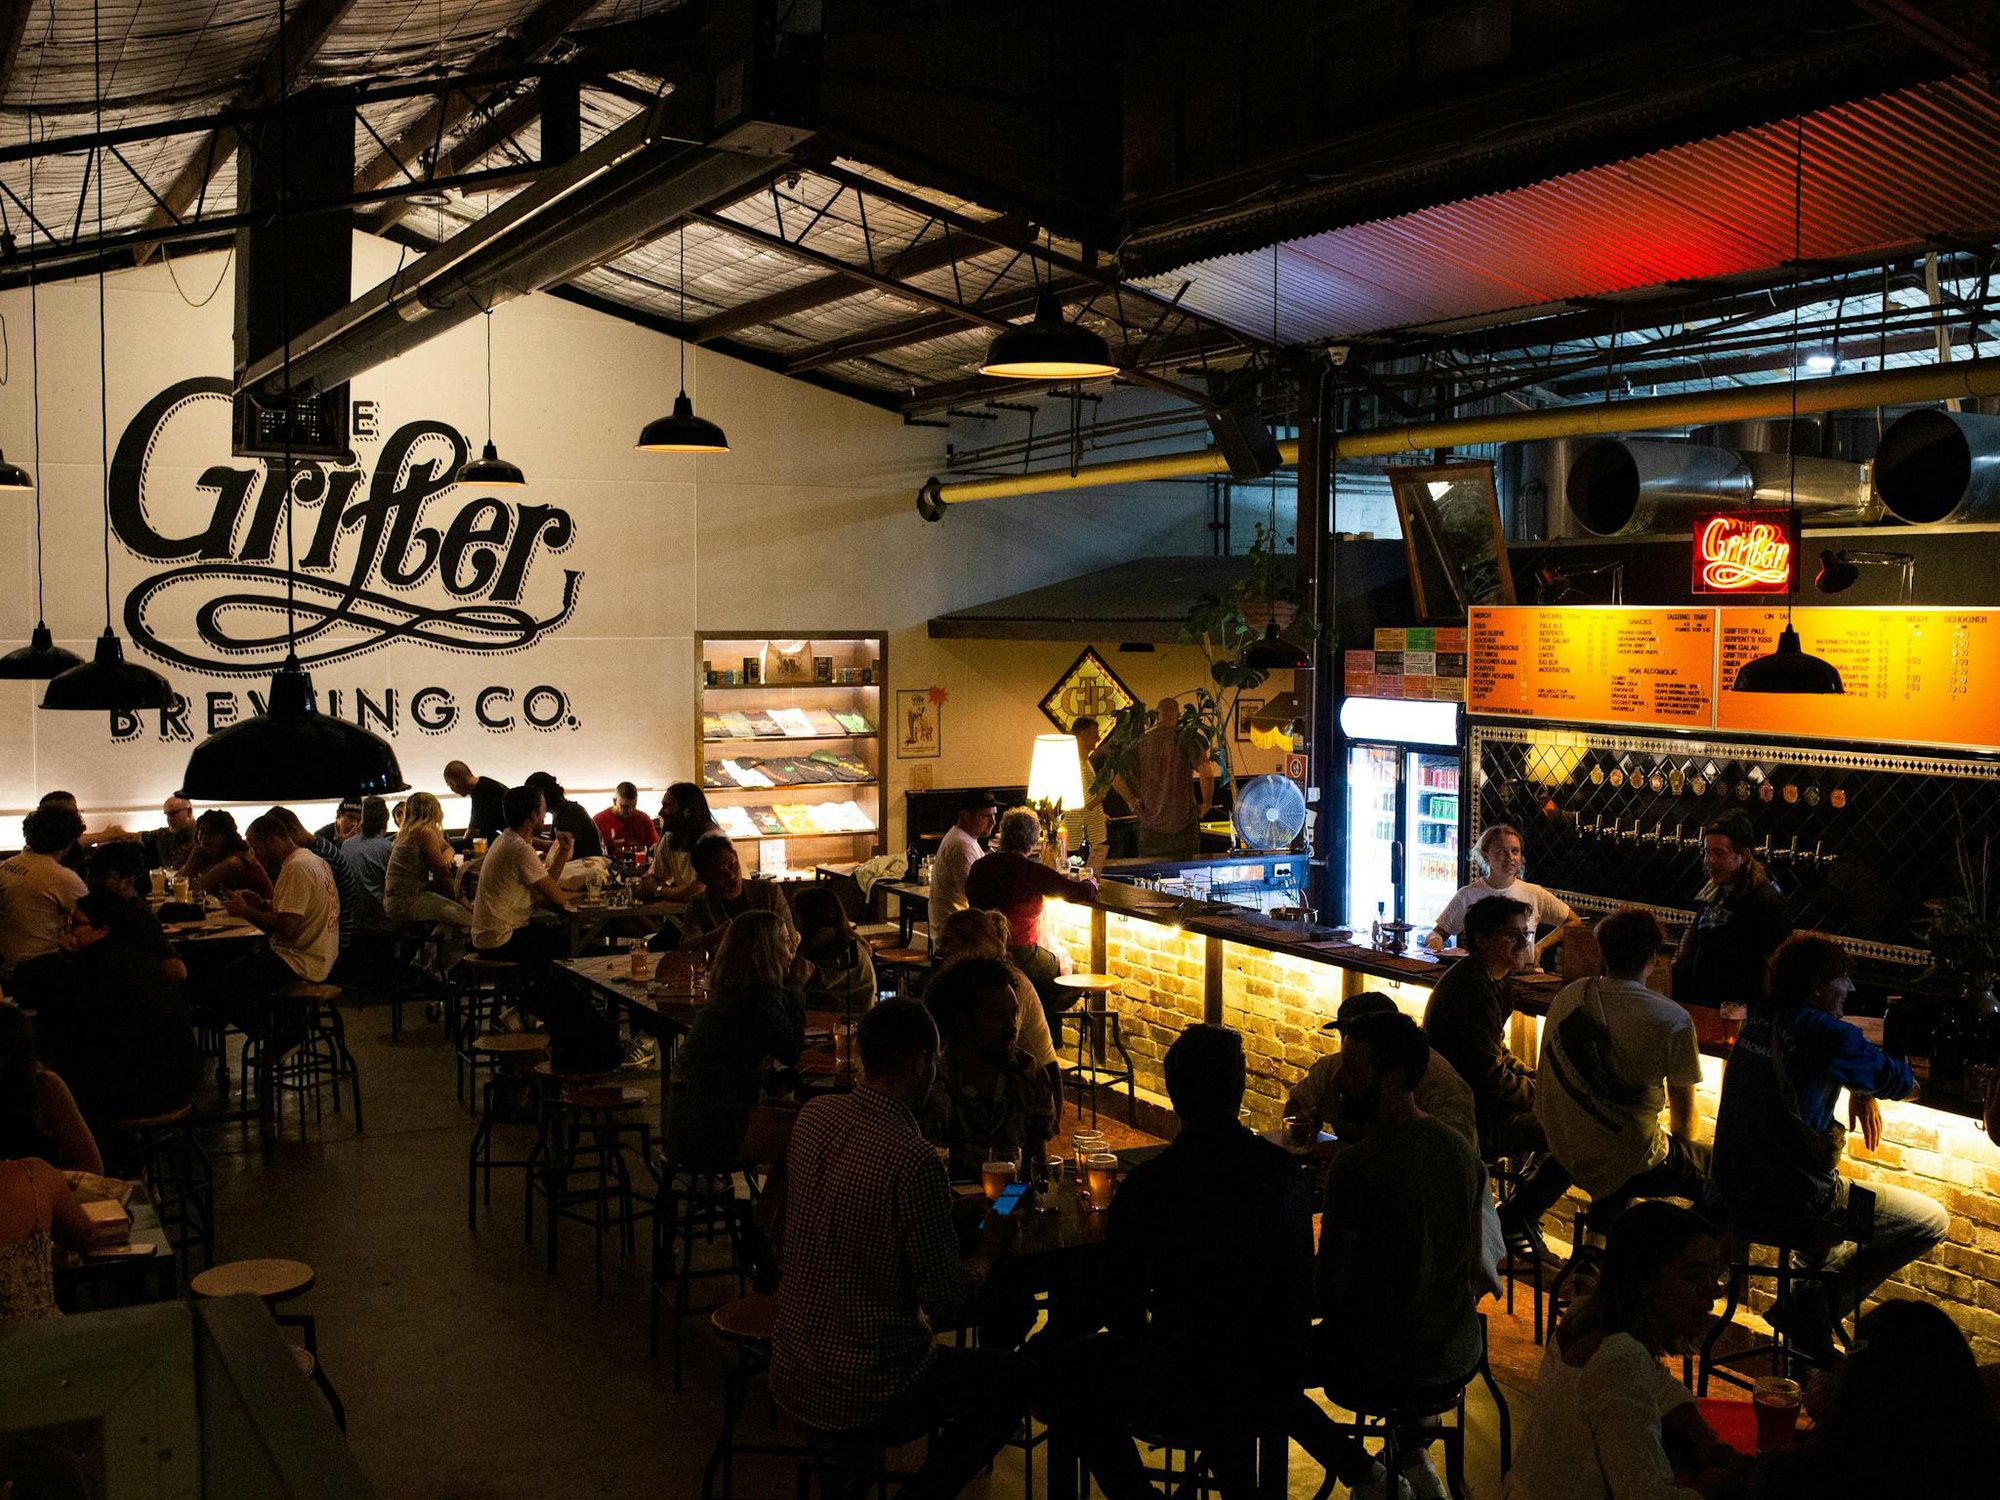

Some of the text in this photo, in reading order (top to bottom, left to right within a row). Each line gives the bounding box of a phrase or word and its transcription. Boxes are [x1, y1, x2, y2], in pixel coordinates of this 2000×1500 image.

[108, 376, 582, 676] Grifter
[109, 684, 580, 743] BREING CO.
